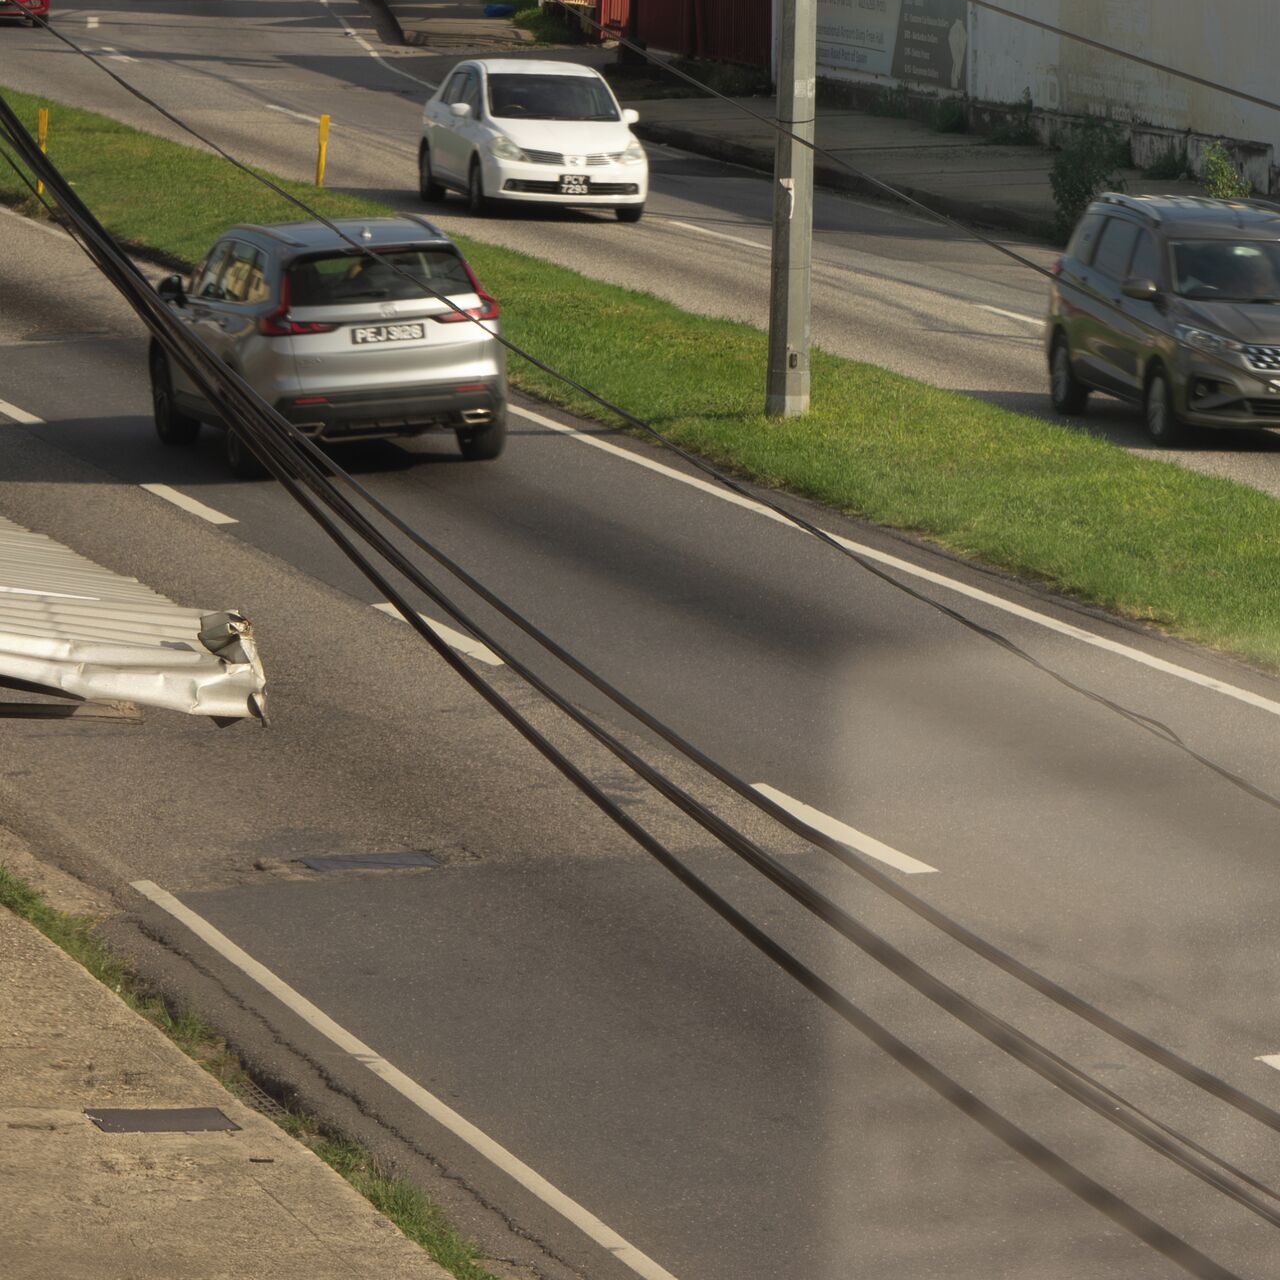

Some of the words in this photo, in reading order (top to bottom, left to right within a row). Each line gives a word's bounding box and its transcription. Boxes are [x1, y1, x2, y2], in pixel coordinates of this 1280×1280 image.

[563, 175, 585, 185] PCY
[560, 184, 588, 194] 7293
[355, 327, 387, 342] PEJ
